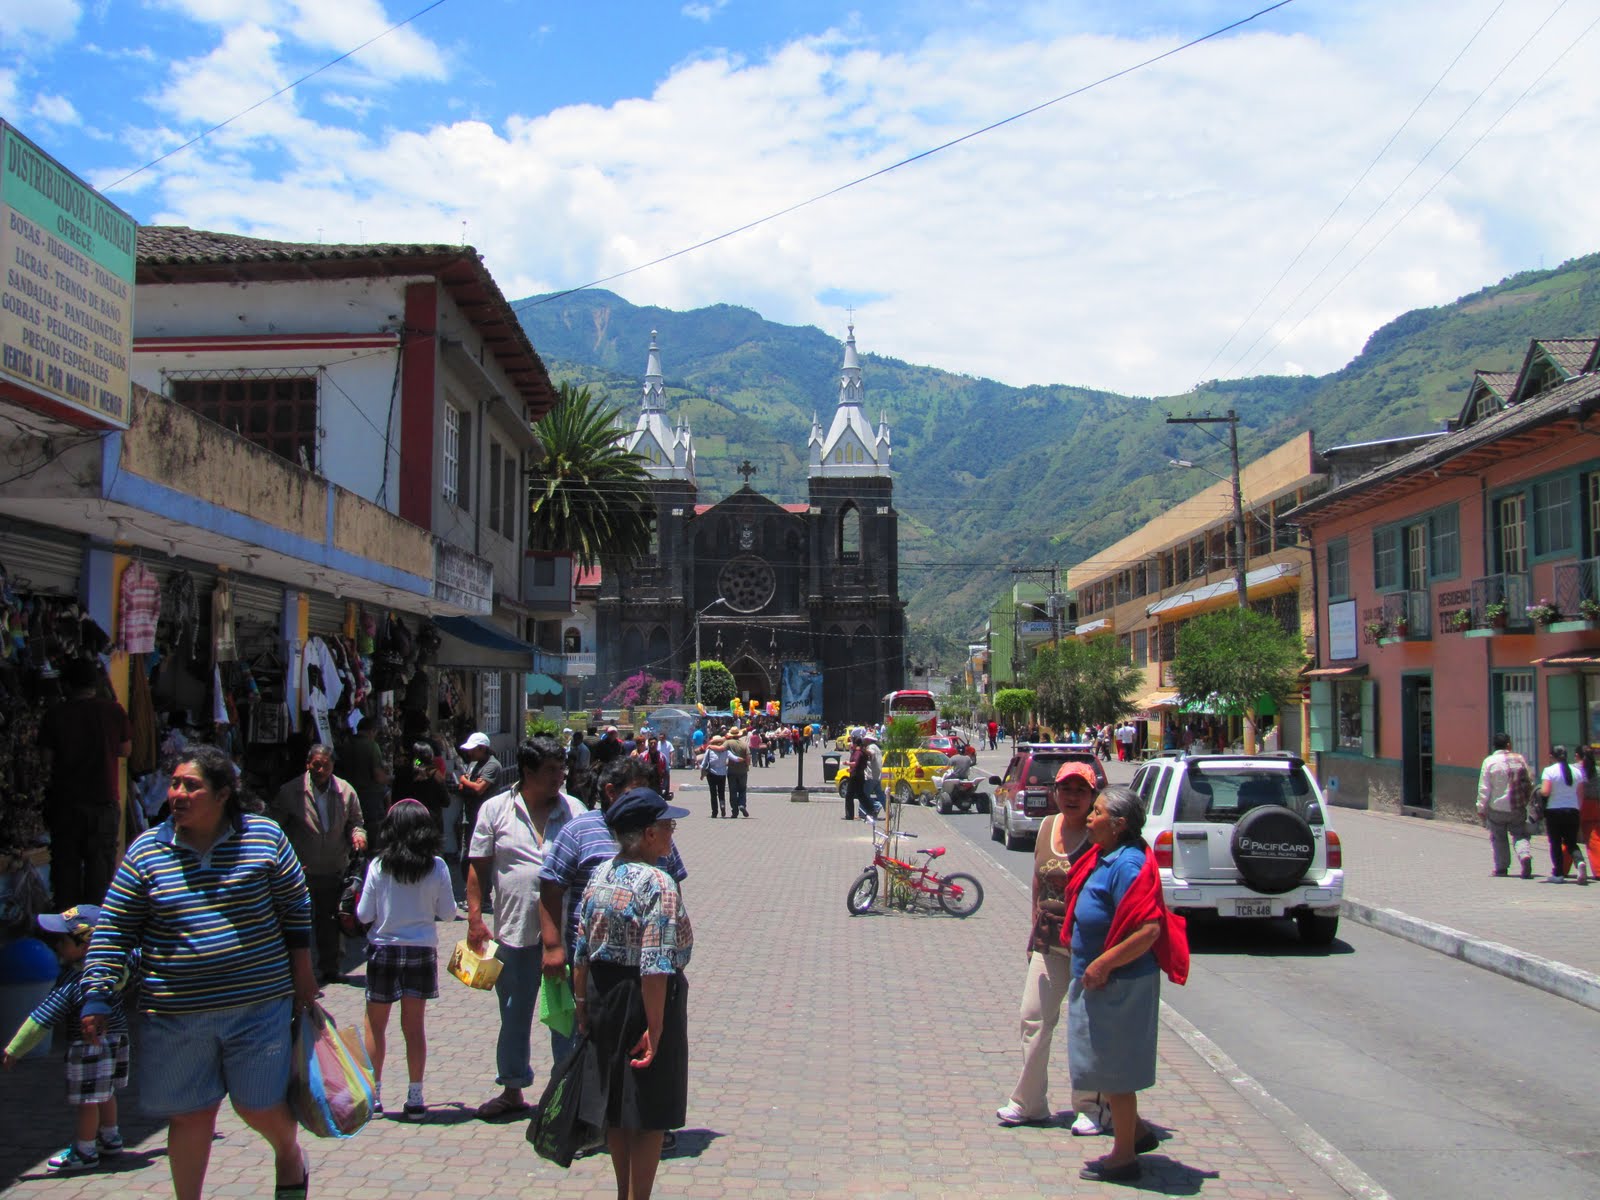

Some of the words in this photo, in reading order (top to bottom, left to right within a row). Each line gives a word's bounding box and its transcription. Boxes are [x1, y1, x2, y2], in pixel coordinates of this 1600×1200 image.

[8, 138, 92, 228] DISTRIBUIDORA
[93, 201, 132, 256] JOSIMAR
[10, 212, 40, 246] BOYAS
[48, 236, 89, 277] JUGUETES
[95, 267, 127, 300] TOALLAS
[16, 246, 48, 280] LICRAS
[55, 270, 87, 303] TERNOS
[89, 291, 98, 310] DE
[2, 292, 40, 326] GORRAS
[47, 315, 89, 351] PELUCHES
[94, 341, 126, 371] REGALOS
[8, 269, 58, 312] SANDALIAS
[64, 302, 122, 346] PANTALONETAS
[3, 343, 33, 378] VENTAS
[35, 358, 45, 384] AL
[47, 364, 63, 391] POR
[66, 373, 91, 402] MAYOR
[92, 385, 97, 406] Y
[22, 327, 60, 360] PRECIOS
[63, 347, 109, 384] ESPECIALES
[1236, 906, 1271, 916] TCR-448
